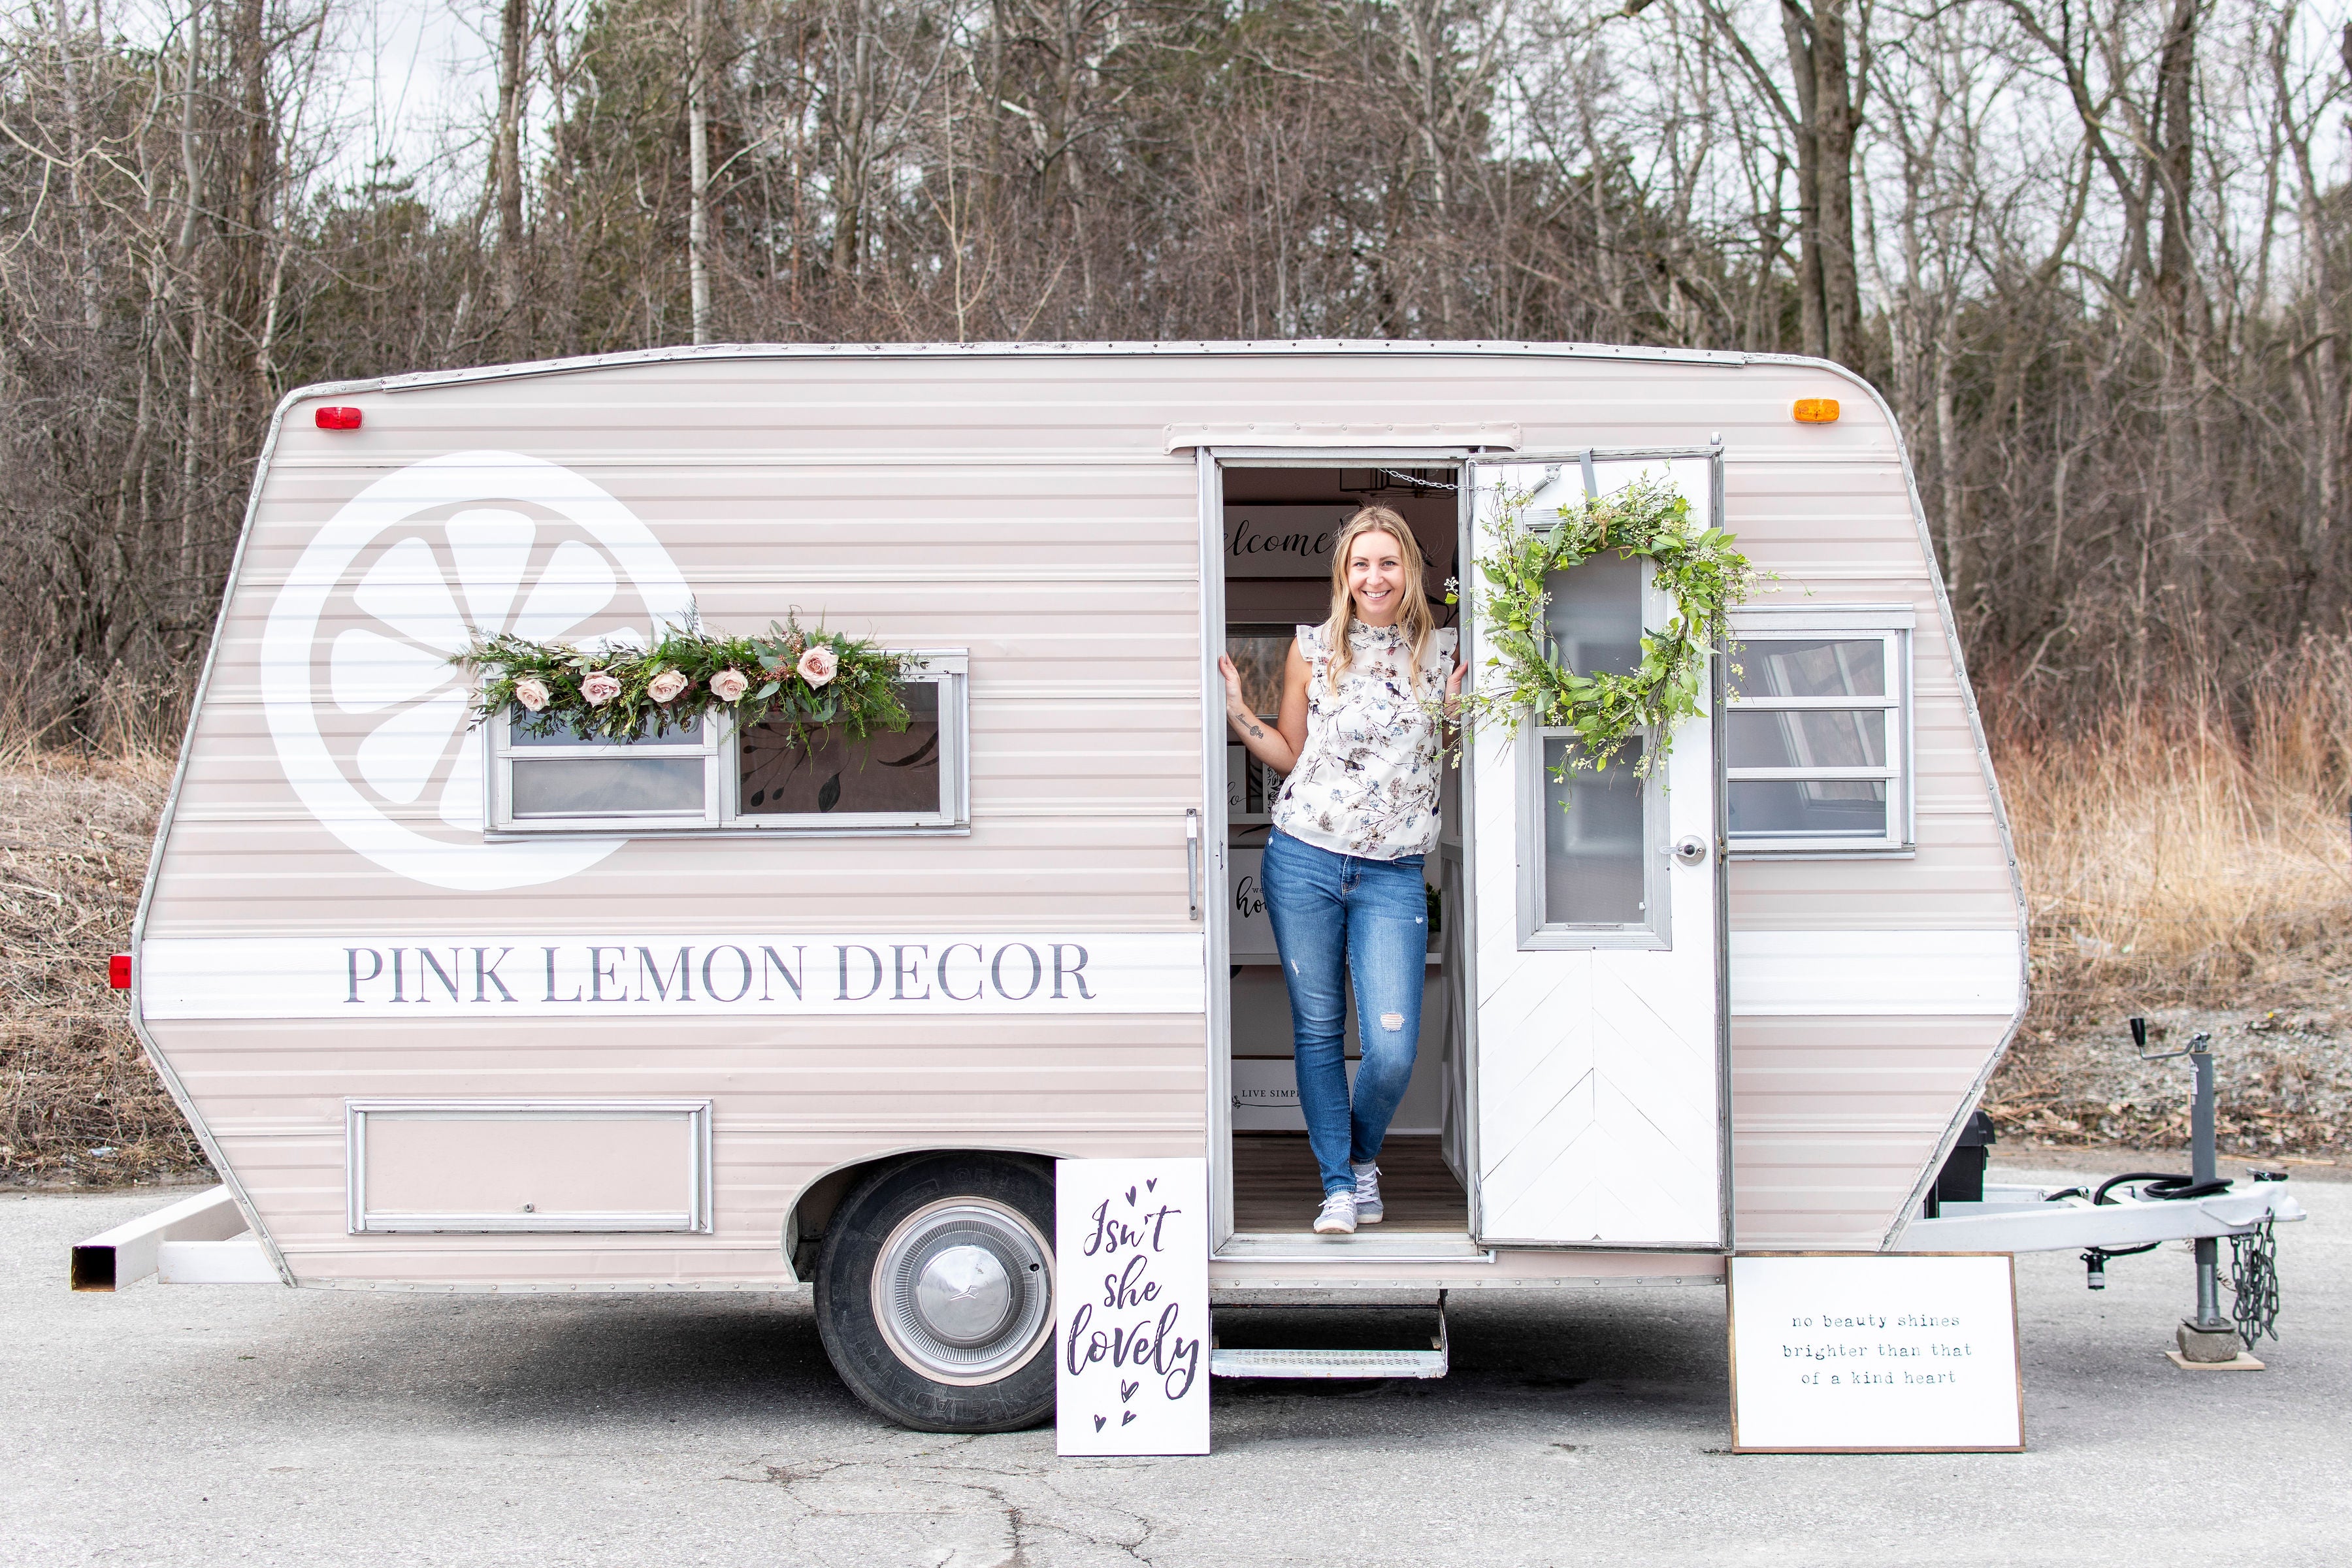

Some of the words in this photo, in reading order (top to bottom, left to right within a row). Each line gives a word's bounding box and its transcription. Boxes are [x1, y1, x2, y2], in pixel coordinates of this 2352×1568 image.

[343, 947, 518, 1003] PINK
[540, 945, 807, 1002] LEMON
[834, 943, 1097, 1001] DECOR
[1083, 1198, 1182, 1257] Isn't
[1103, 1254, 1162, 1309] she
[1792, 1317, 1812, 1327] no
[1823, 1315, 1887, 1329] beauty
[1897, 1315, 1960, 1327] shines
[1067, 1301, 1200, 1401] lovely
[1783, 1345, 1867, 1360] brighter
[1878, 1344, 1921, 1357] than
[1931, 1344, 1972, 1357] that
[1801, 1372, 1820, 1384] of
[1831, 1375, 1841, 1384] a
[1851, 1372, 1893, 1384] kind
[1904, 1371, 1956, 1384] heart
